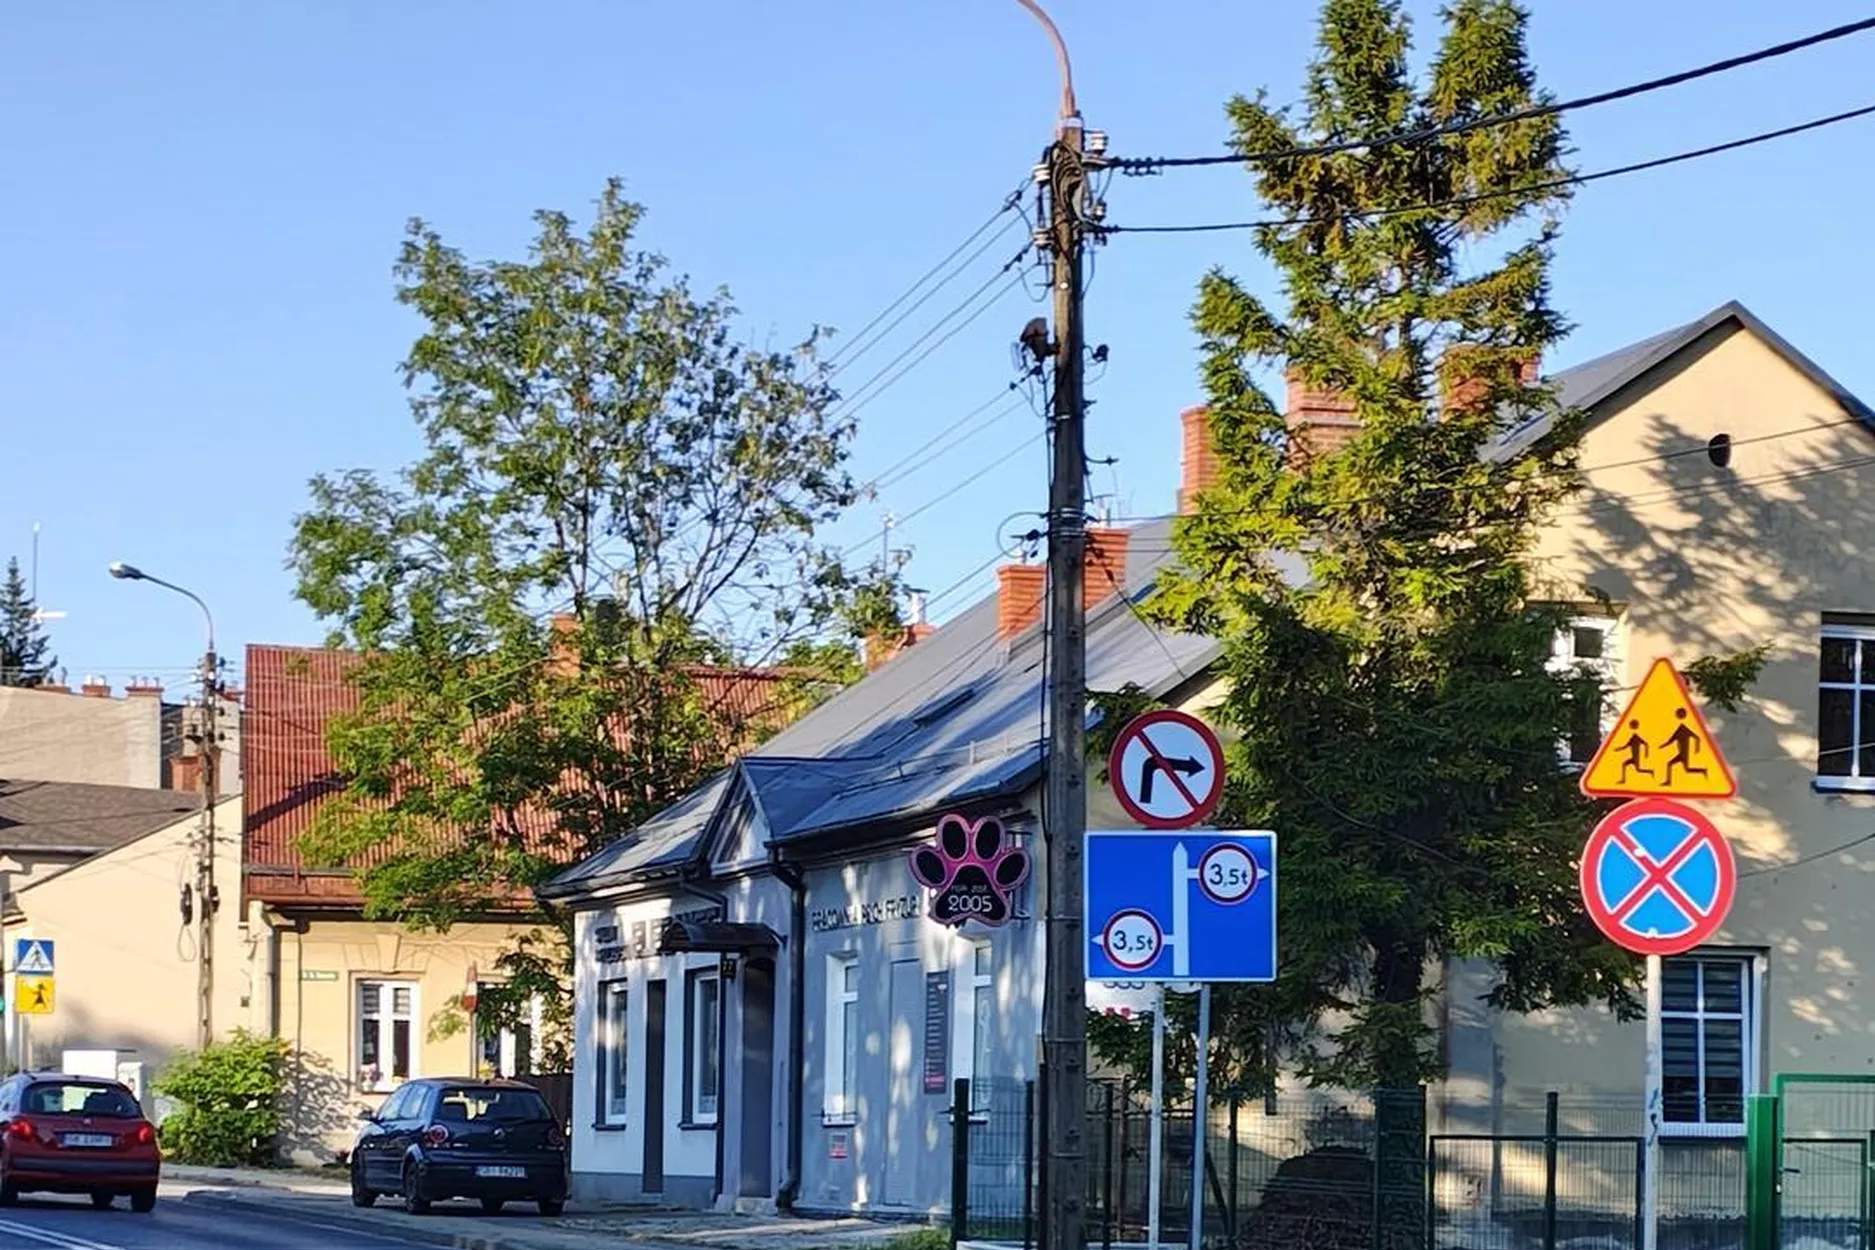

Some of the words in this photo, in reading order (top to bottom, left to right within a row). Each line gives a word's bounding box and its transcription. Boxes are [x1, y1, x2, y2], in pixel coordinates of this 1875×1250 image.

[1209, 863, 1248, 887] 3,5t
[948, 895, 992, 912] 2005
[1113, 930, 1153, 952] 3,5t
